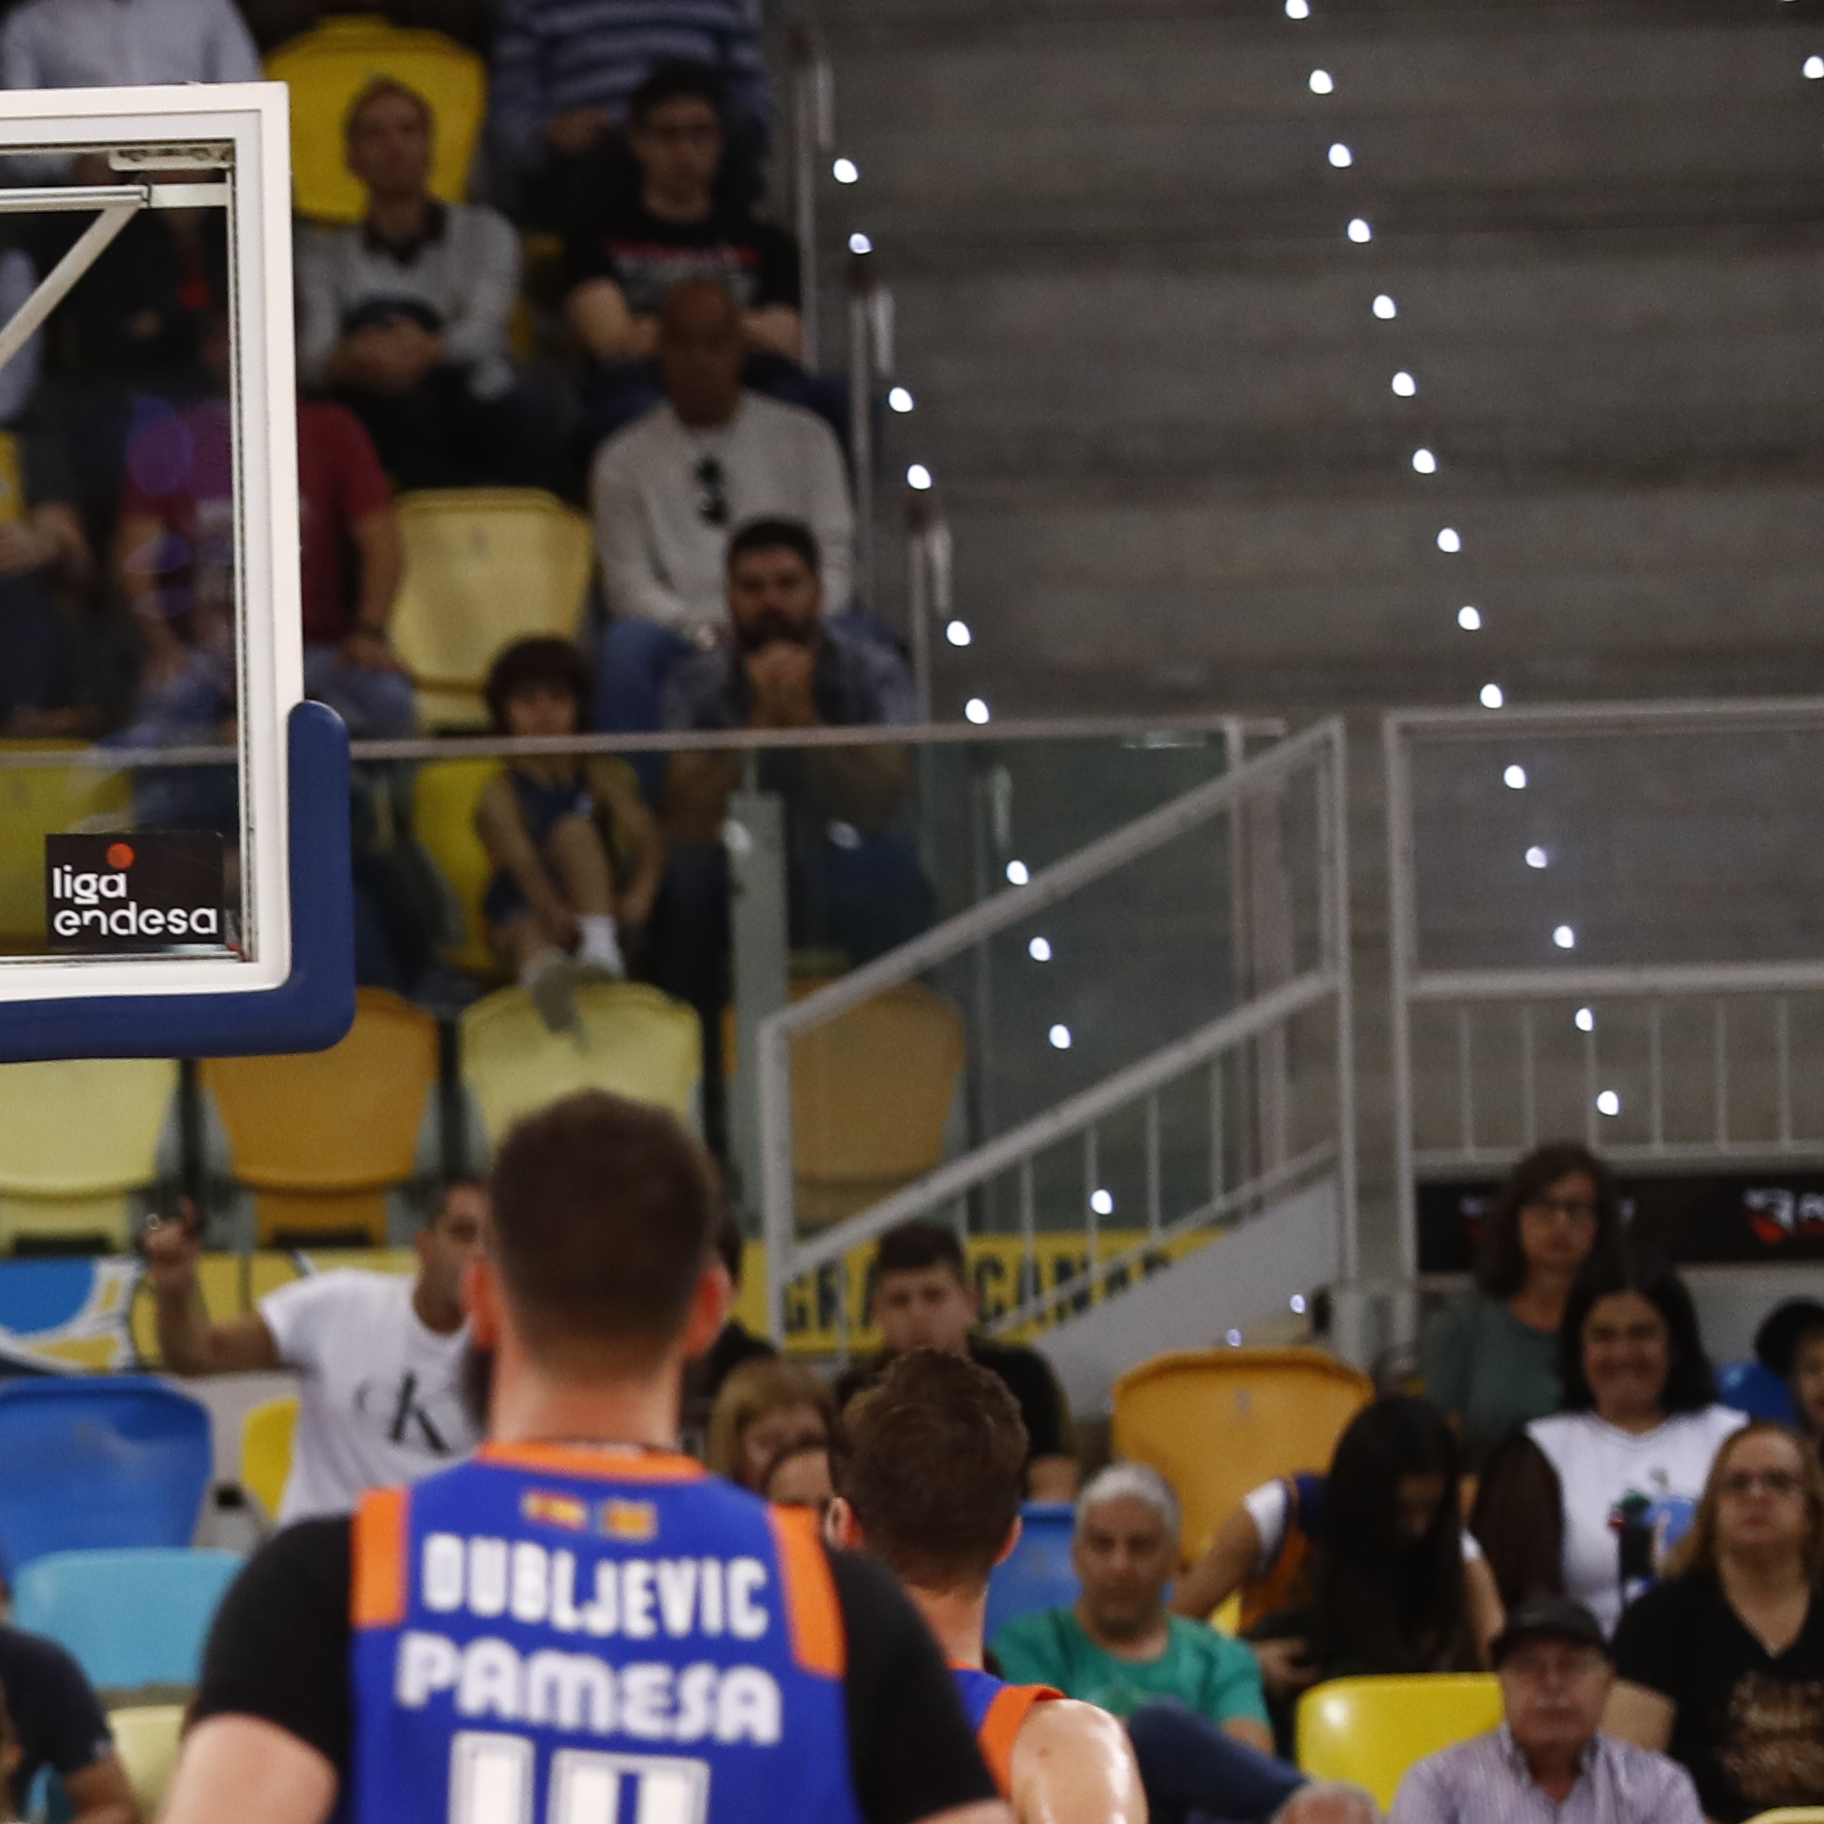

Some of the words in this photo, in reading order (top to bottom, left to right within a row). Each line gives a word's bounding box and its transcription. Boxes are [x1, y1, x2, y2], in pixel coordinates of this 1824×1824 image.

[53, 864, 127, 905] liga
[54, 901, 218, 937] endesa
[423, 1532, 768, 1640] DUBLJEVIC
[395, 1630, 782, 1746] PAMESA
